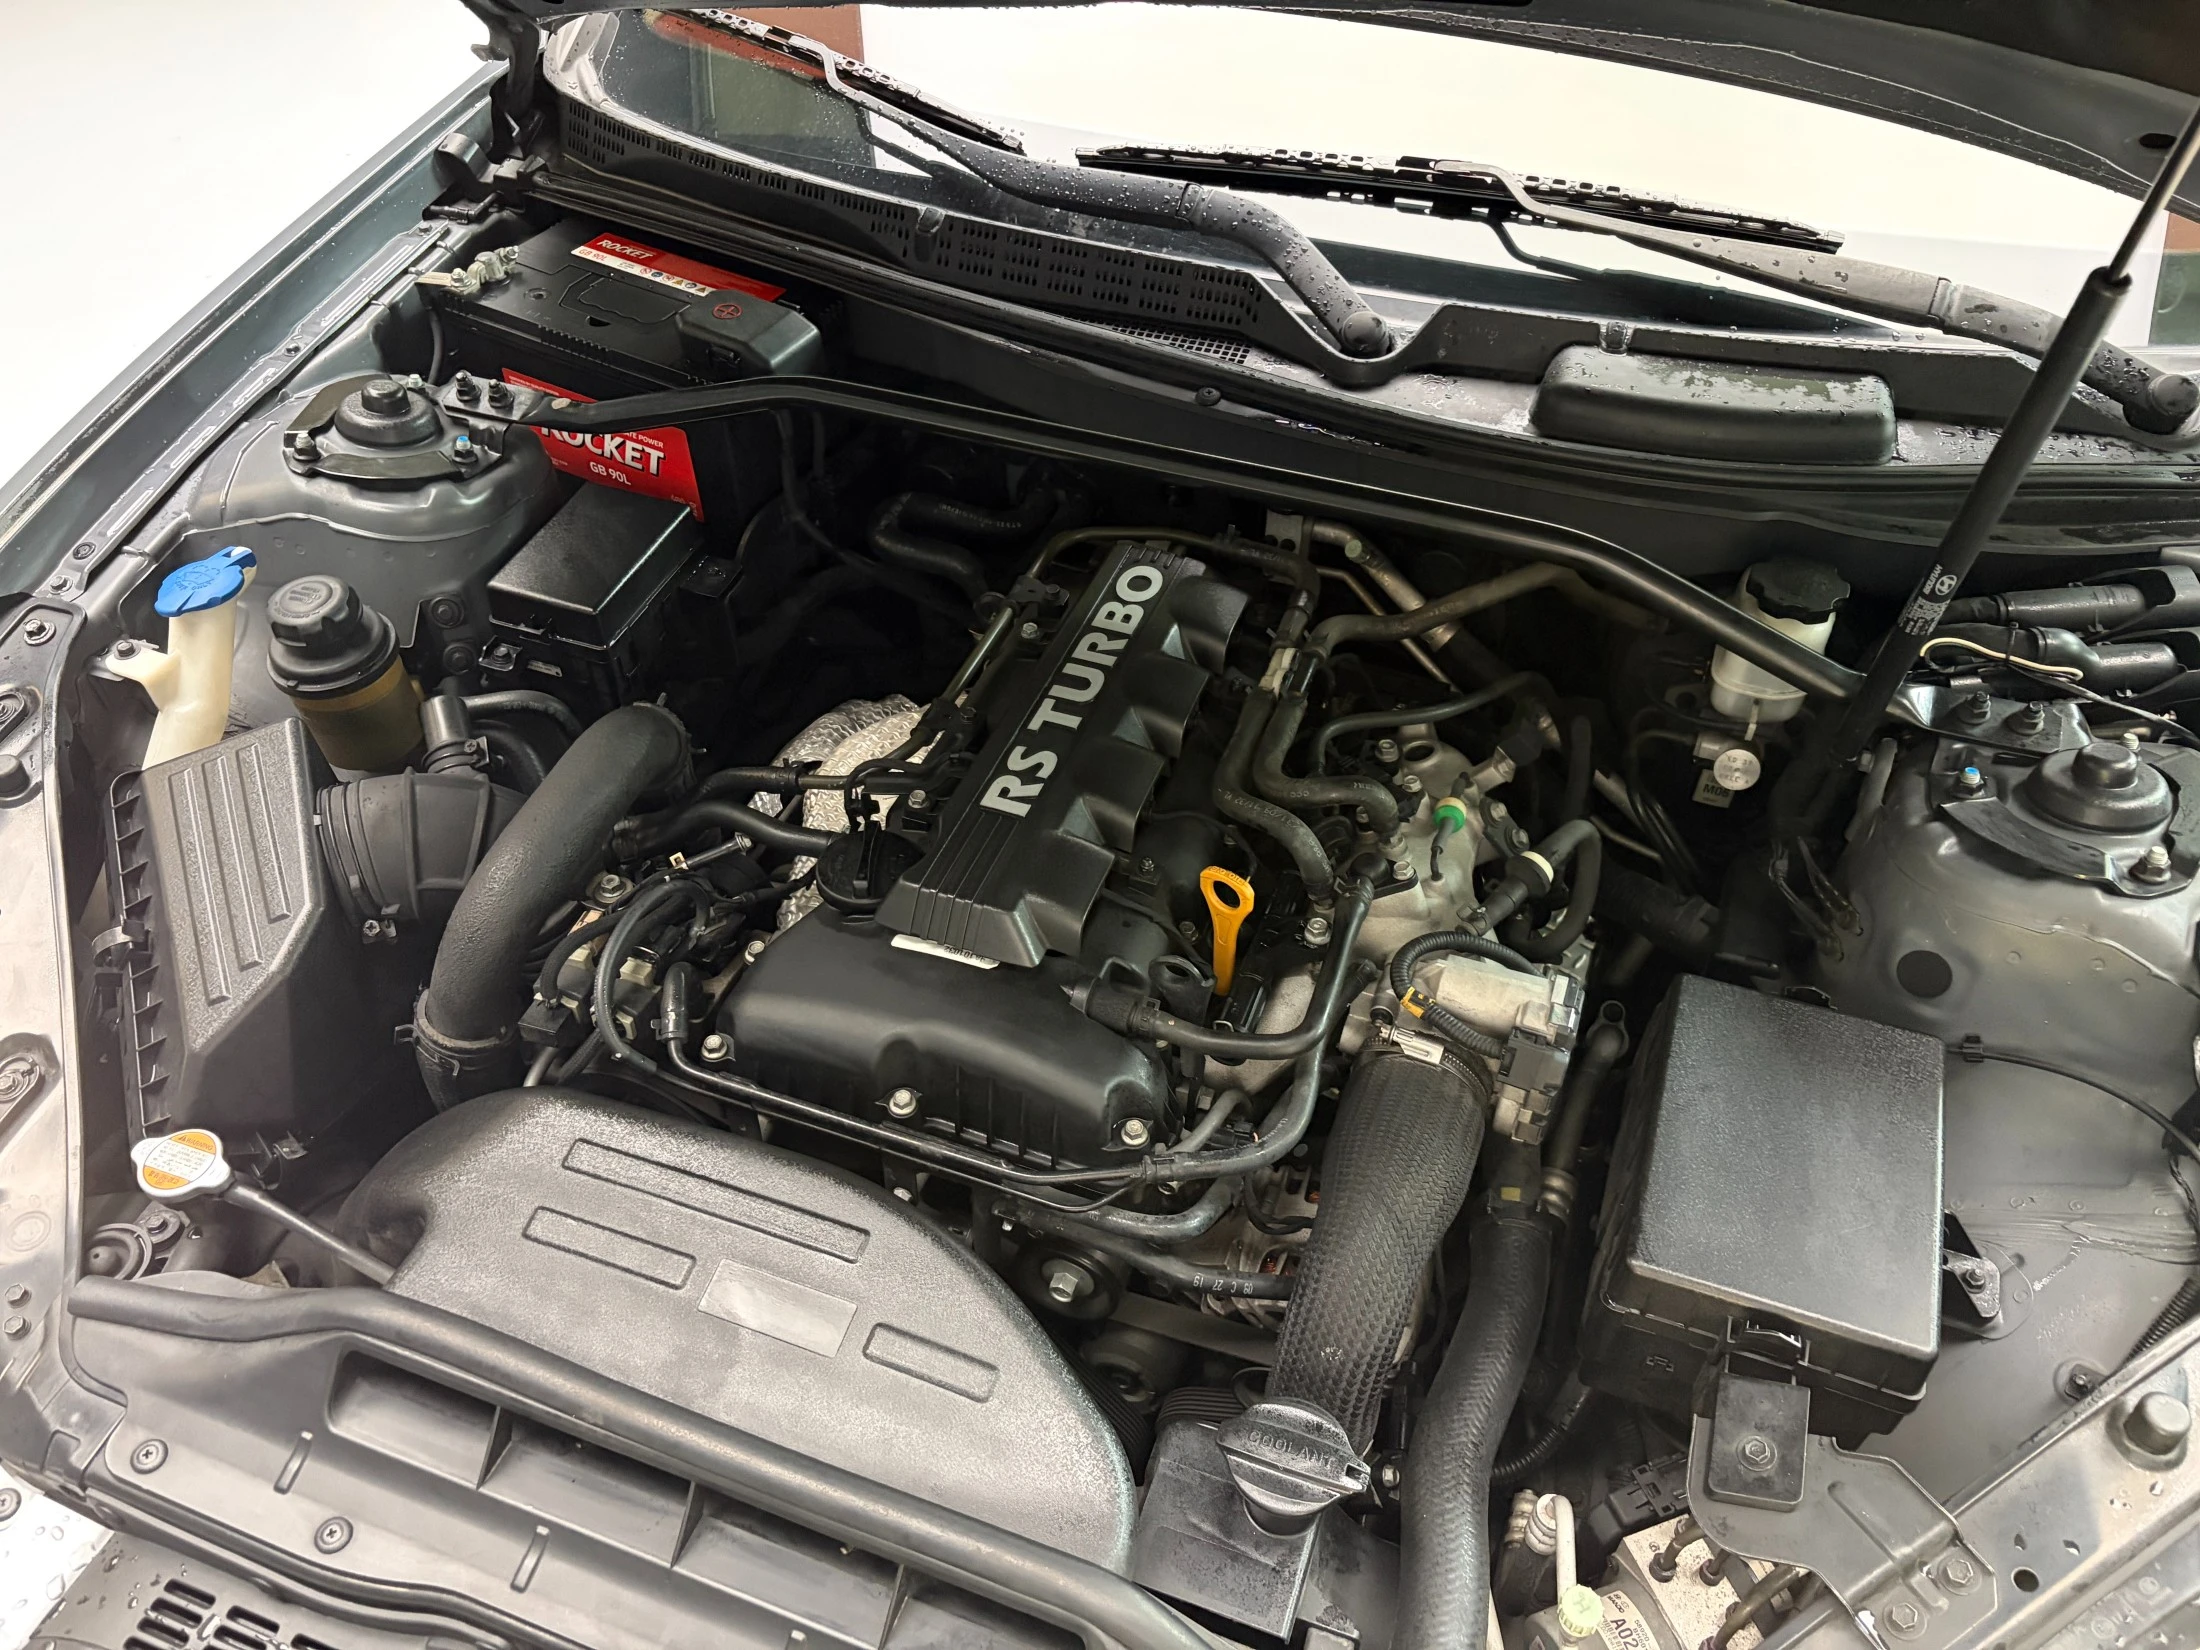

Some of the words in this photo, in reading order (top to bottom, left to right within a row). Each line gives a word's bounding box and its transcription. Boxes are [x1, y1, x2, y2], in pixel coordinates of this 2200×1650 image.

[597, 239, 653, 259] ROCKET
[638, 433, 664, 448] POWER
[590, 461, 607, 476] GB
[609, 468, 631, 485] 90L
[1923, 564, 1943, 594] HYUNDAI
[980, 745, 1058, 817] RS
[1027, 565, 1163, 731] TURBO
[1212, 1280, 1223, 1291] 27
[1230, 1281, 1237, 1293] C
[1243, 1282, 1253, 1294] 09
[1249, 1430, 1335, 1469] COOLANT
[1611, 1619, 1639, 1650] A02
